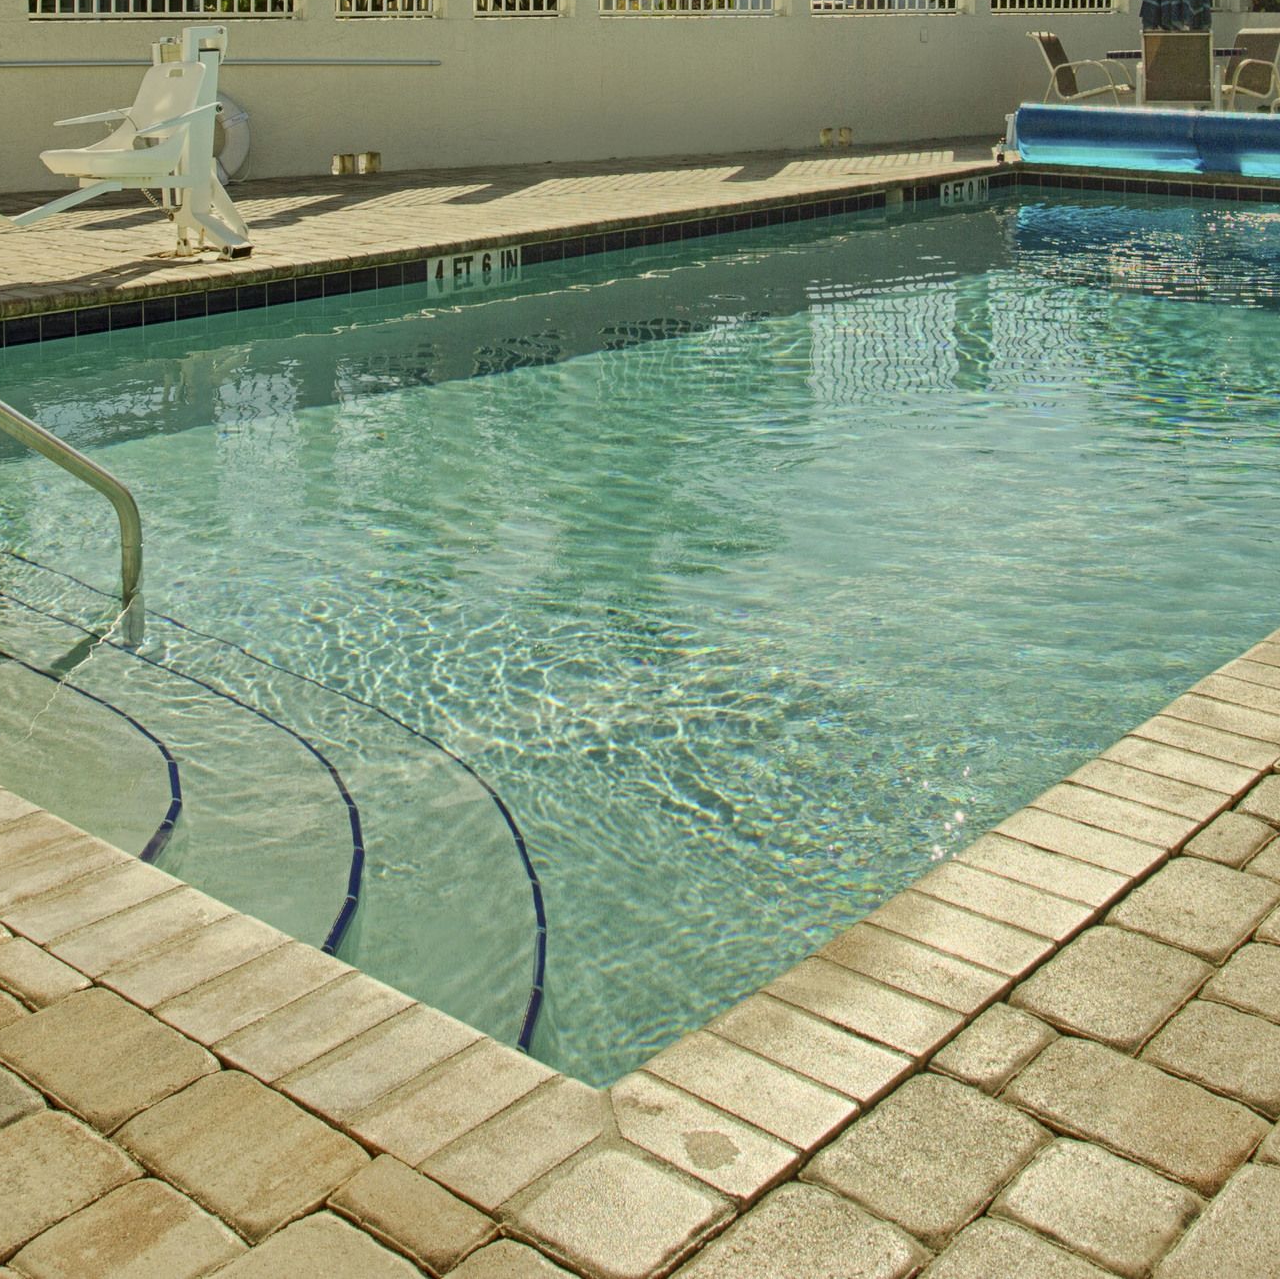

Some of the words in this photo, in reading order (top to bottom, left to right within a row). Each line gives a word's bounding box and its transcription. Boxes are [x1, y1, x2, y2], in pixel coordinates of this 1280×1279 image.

[435, 259, 444, 280] 4
[453, 255, 474, 277] FT
[482, 252, 492, 272] 6
[500, 248, 518, 269] IN
